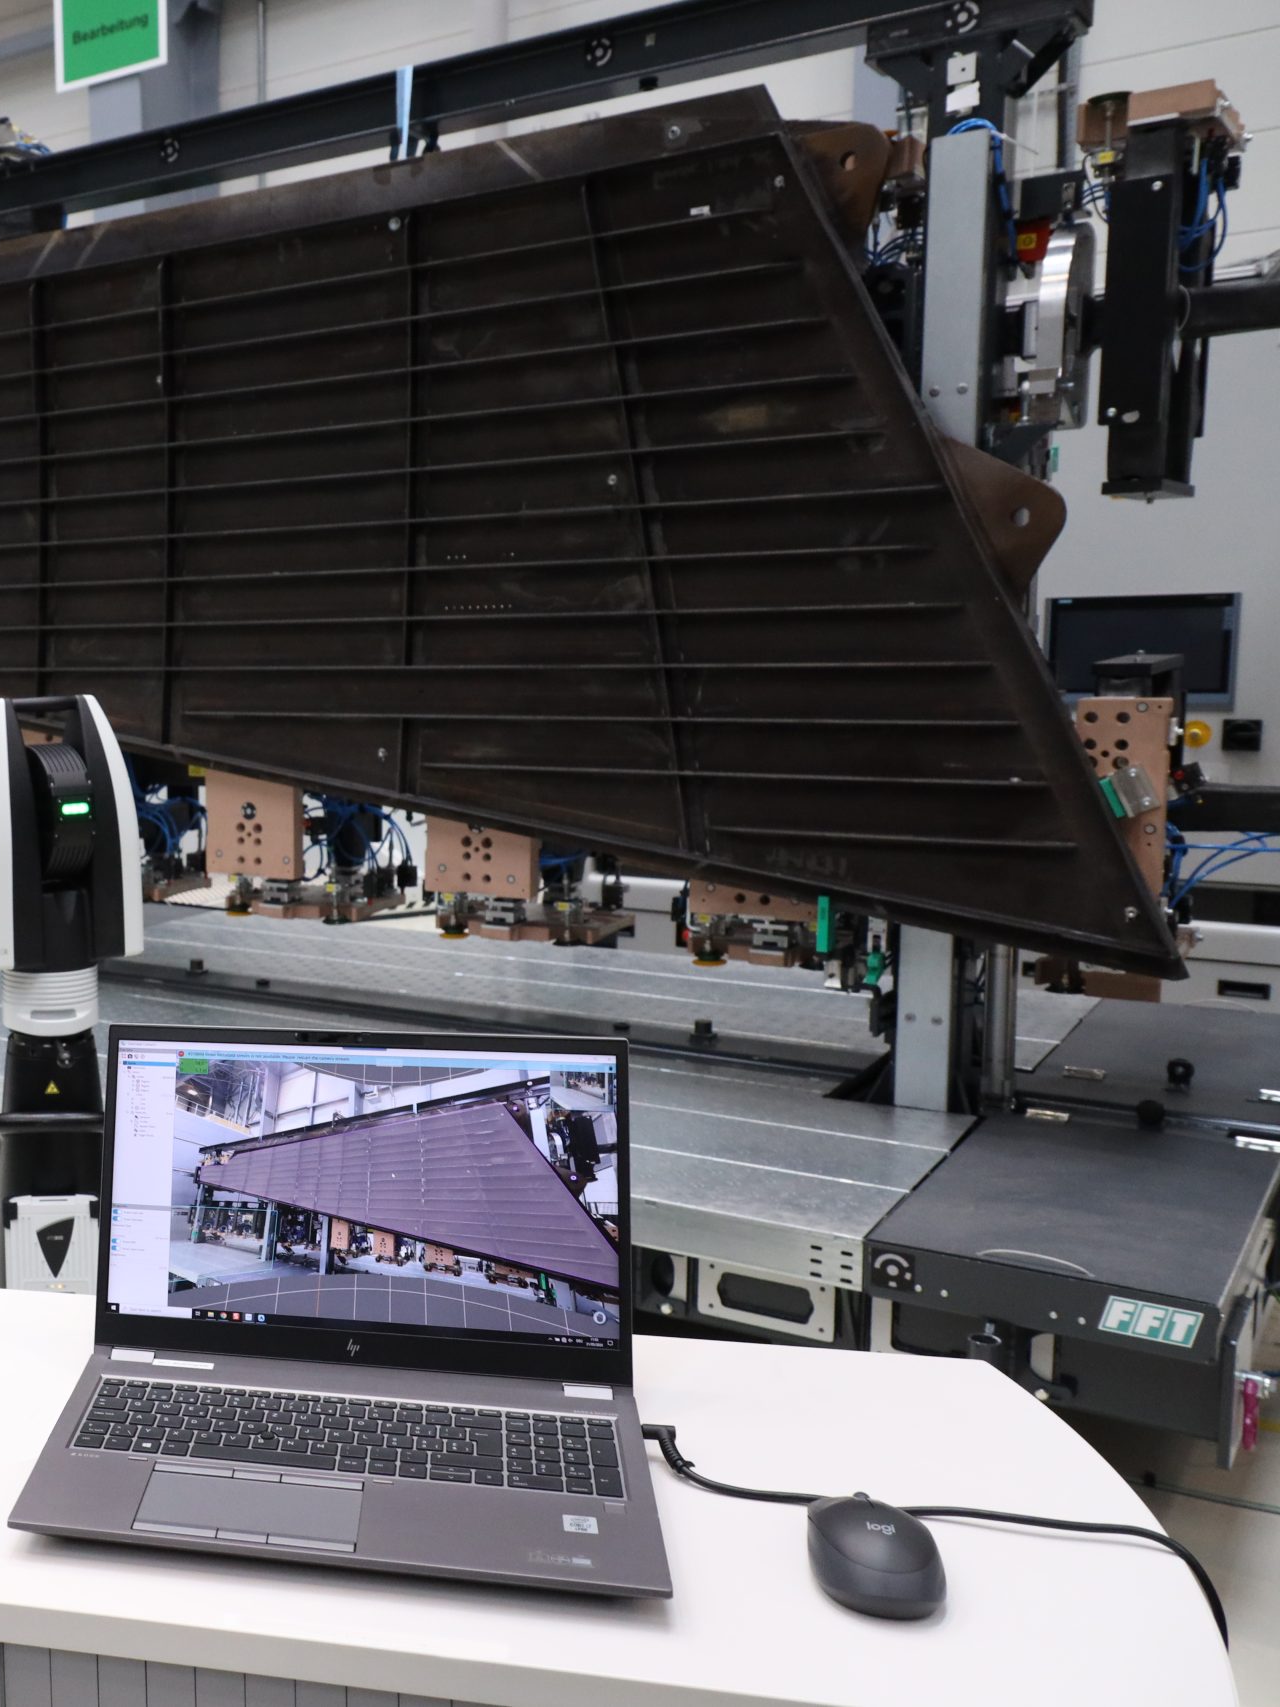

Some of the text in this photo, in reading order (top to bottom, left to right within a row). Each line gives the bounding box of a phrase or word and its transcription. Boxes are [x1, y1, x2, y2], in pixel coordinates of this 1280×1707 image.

[72, 14, 149, 45] Bearbeitung
[1104, 1300, 1198, 1342] FFT
[347, 1338, 360, 1357] hp
[866, 1521, 896, 1536] logi
